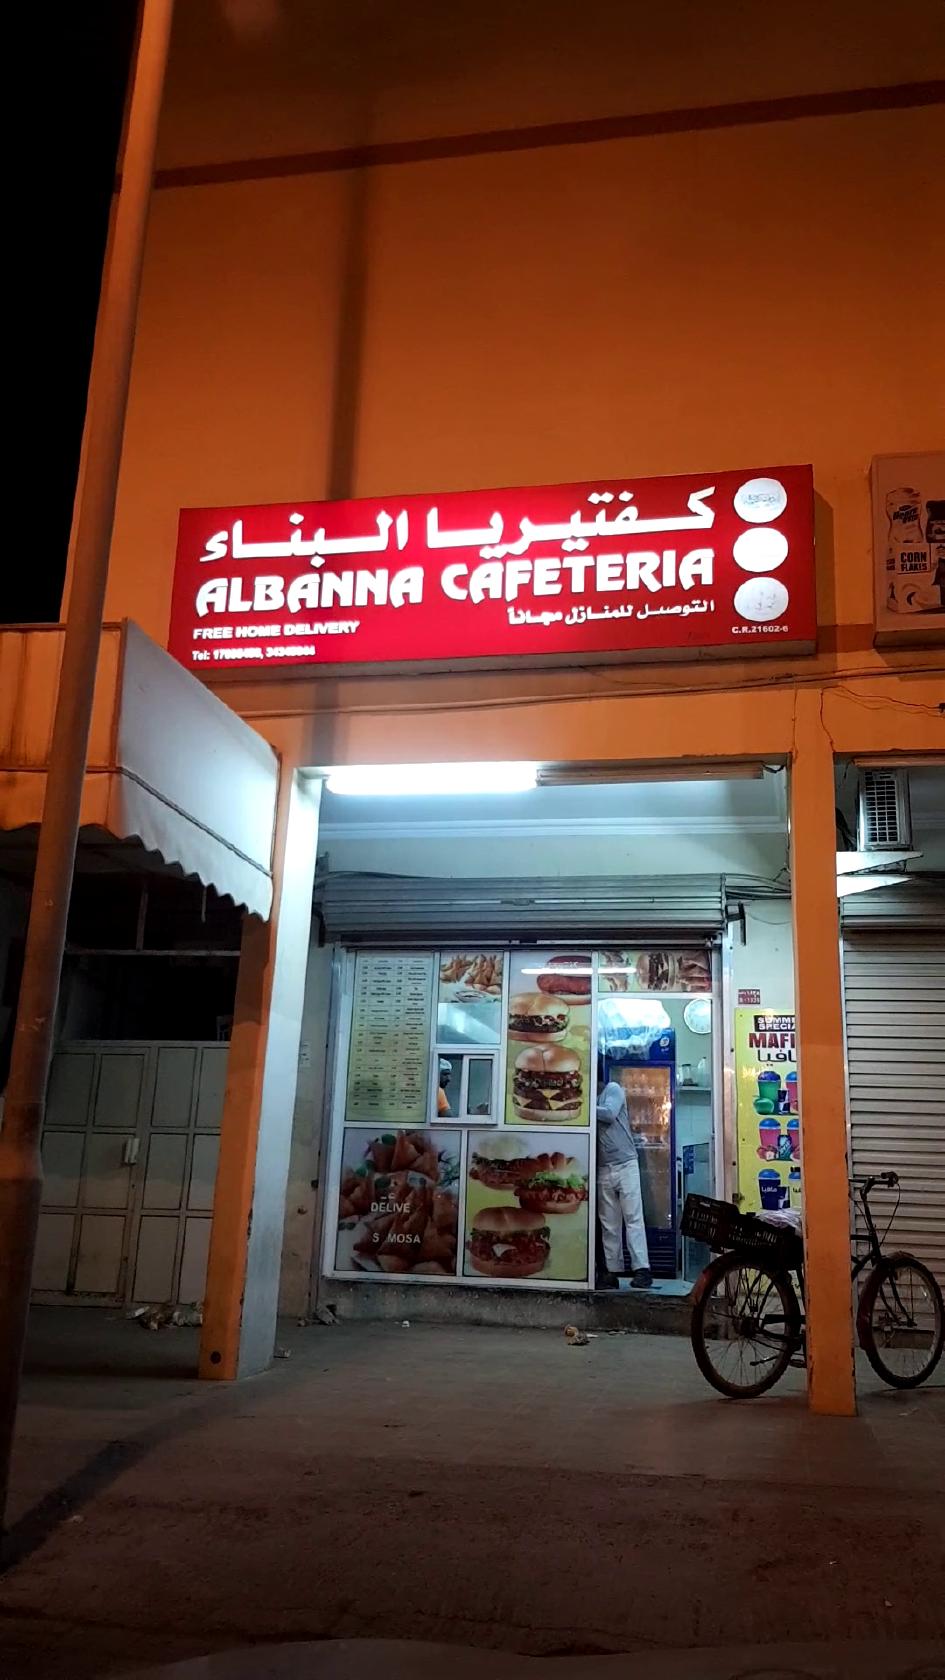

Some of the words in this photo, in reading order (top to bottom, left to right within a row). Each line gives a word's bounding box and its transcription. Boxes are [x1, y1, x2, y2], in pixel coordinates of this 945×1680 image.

[426, 486, 716, 560] كفتيريا
[199, 509, 409, 568] البناء
[900, 551, 928, 563] CORN
[900, 562, 928, 572] FLAKES
[195, 566, 425, 618] ALBANNA
[440, 548, 716, 604] CAFETERIA
[193, 626, 234, 640] FREE
[235, 624, 282, 639] HOME
[283, 619, 361, 637] DELIVERY
[191, 649, 211, 661] Tel:
[757, 1049, 797, 1067] افيا
[370, 1201, 411, 1214] DELIVE
